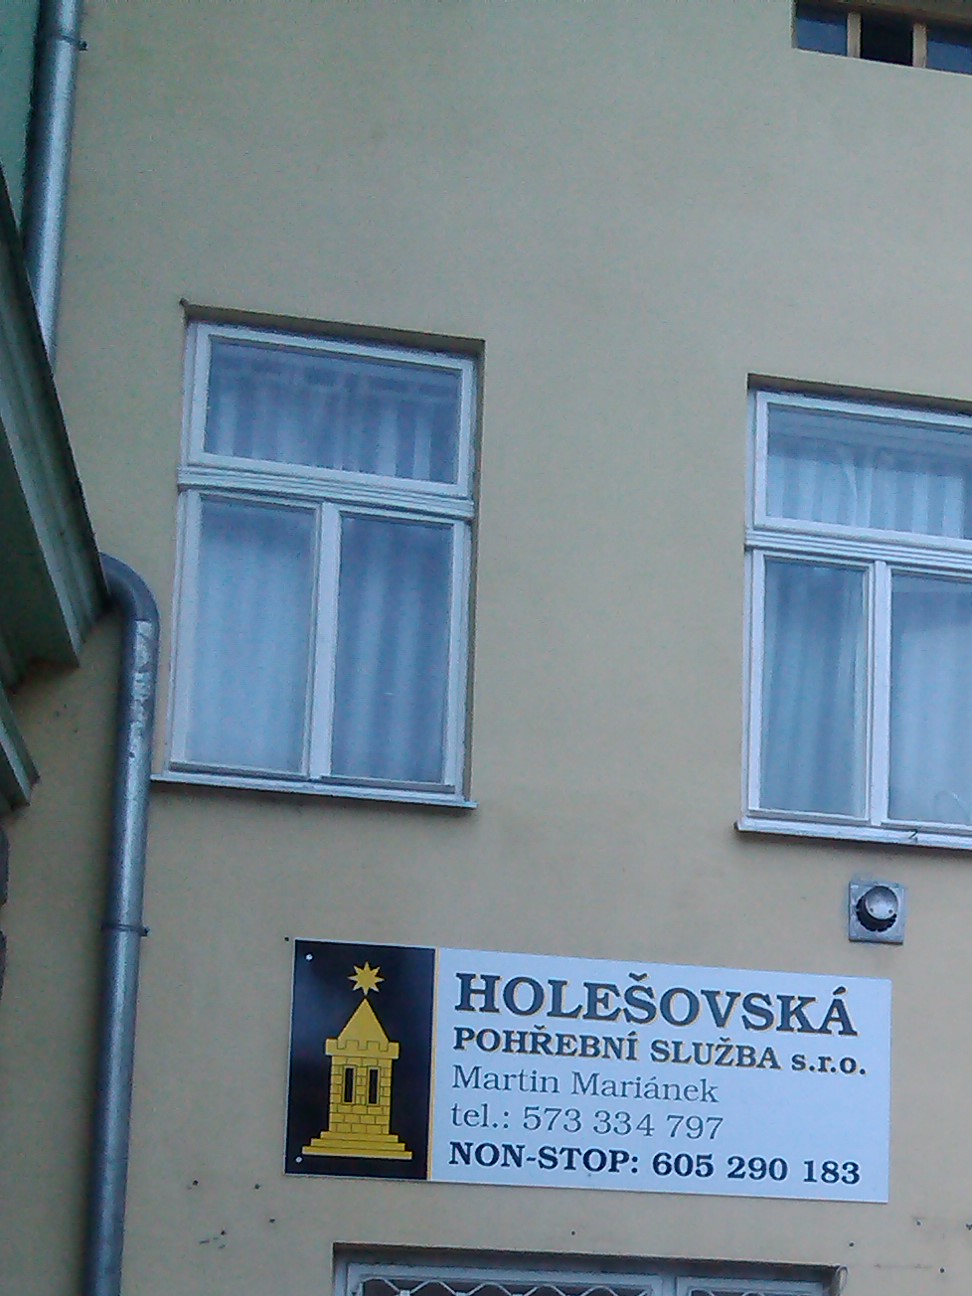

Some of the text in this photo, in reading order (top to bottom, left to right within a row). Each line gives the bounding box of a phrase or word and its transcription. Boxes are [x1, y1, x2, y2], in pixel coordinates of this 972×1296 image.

[454, 971, 858, 1037] HOLEŠOVSKÁ
[453, 1026, 866, 1076] POHŘEBNÍ SLUŽBA s.r.o.
[452, 1064, 719, 1104] Martin Mariánek
[451, 1103, 722, 1141] tel.: 573 334 797
[449, 1141, 861, 1185] NON-STOP: 605 290 183
